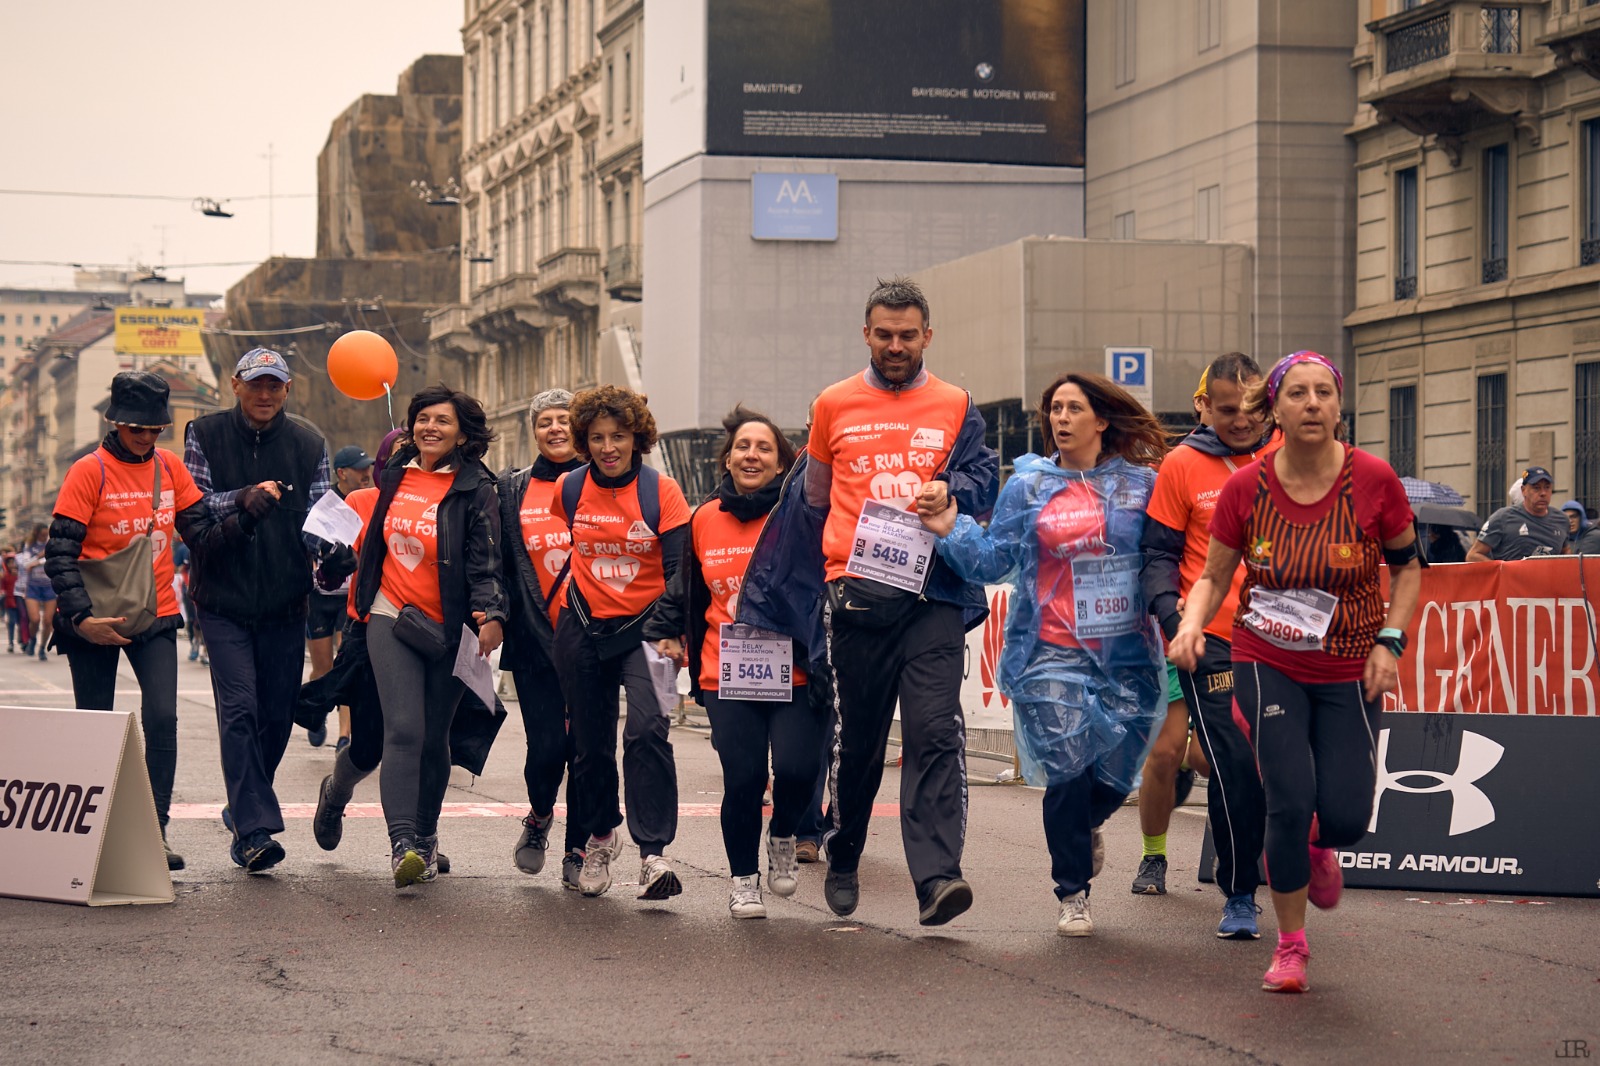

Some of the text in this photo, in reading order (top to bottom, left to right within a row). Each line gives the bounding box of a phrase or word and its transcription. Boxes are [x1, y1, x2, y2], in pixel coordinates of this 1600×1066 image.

[912, 86, 1057, 101] BAYERISCHE MOTOREN WERKE
[120, 314, 199, 325] ESSELUNGA
[1119, 356, 1139, 382] P
[843, 422, 909, 434] AMICHE SPECIALI
[849, 450, 935, 474] WE RUN FOR
[130, 490, 153, 499] SPECIAL
[403, 493, 428, 504] SPECIALI
[878, 482, 918, 500] LILT
[1197, 489, 1222, 501] AMICH
[110, 519, 130, 535] WE
[155, 510, 174, 527] FOR
[392, 516, 412, 534] RUN
[592, 514, 624, 523] SPECIALI
[545, 531, 571, 548] RUN
[881, 529, 914, 541] MARATHON
[394, 541, 421, 556] LILT
[594, 543, 621, 556] RUN
[625, 541, 652, 553] FOR
[727, 546, 755, 555] SPECIA
[872, 543, 909, 567] 543B
[600, 562, 637, 580] LILT
[863, 567, 916, 587] UNDER ARMOUR
[1095, 596, 1129, 615] 638D
[1255, 616, 1304, 643] 2089D
[738, 663, 774, 680] 543A
[1334, 851, 1391, 870] DER
